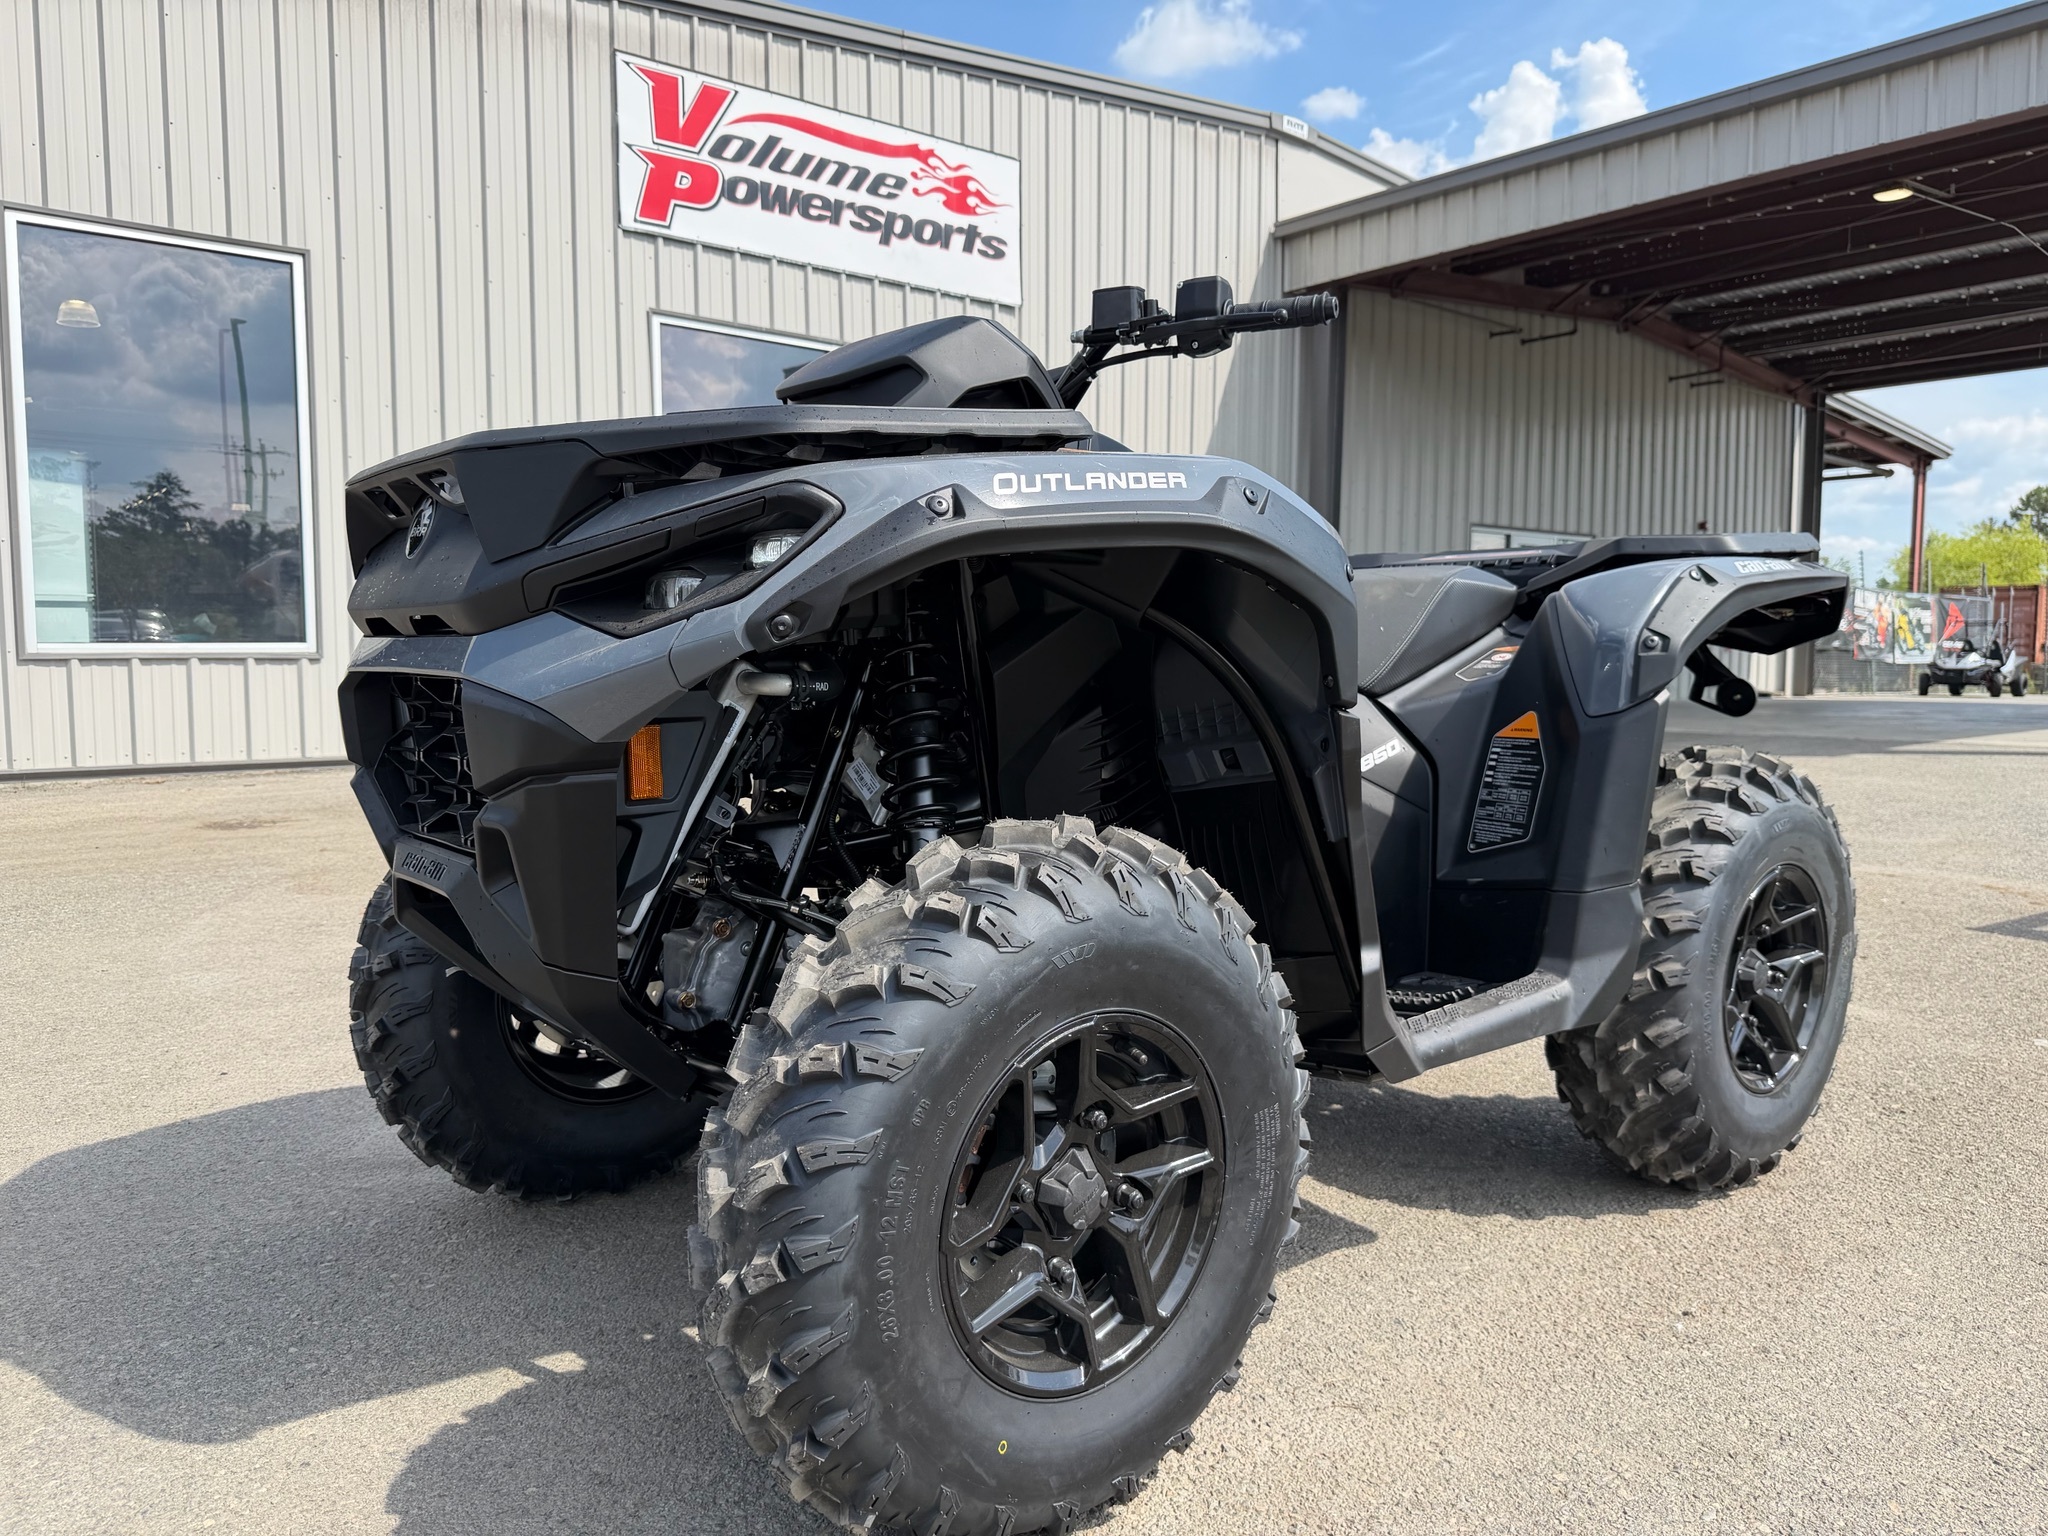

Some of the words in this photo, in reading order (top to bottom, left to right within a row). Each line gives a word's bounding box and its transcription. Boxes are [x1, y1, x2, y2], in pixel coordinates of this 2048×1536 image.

[622, 60, 908, 199] Volume
[624, 142, 1008, 260] Powersports
[993, 472, 1187, 495] OUTLANDER
[815, 682, 829, 691] RAD
[1361, 738, 1400, 772] 850
